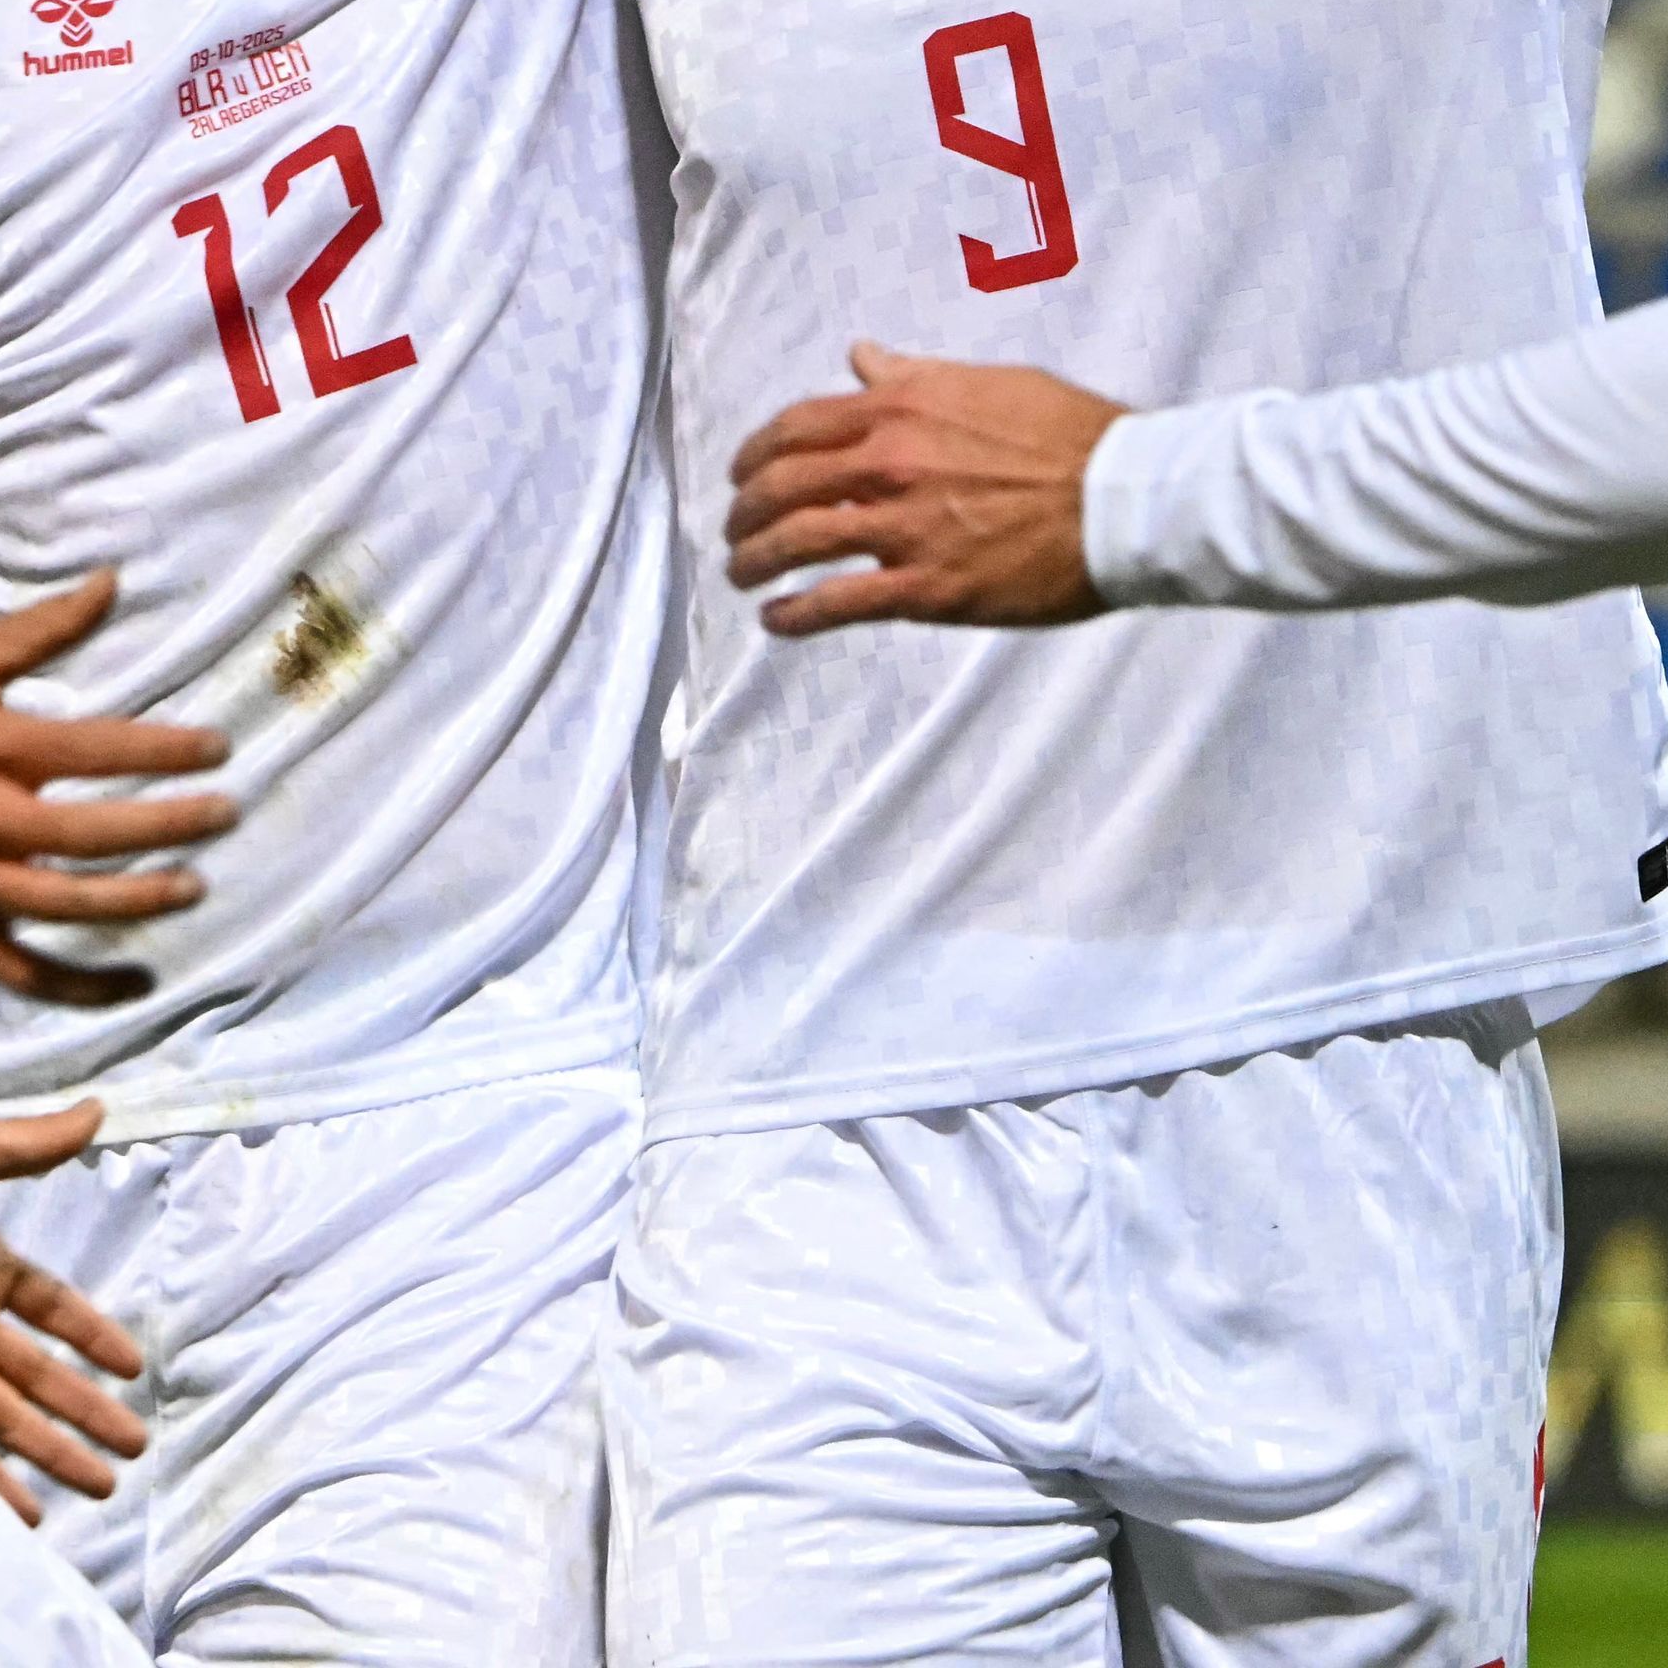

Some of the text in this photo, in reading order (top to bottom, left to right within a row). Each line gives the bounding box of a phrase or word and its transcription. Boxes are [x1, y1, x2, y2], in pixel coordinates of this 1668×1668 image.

[23, 40, 134, 77] hummel
[178, 68, 229, 117] BLR
[249, 40, 312, 91] DEN
[189, 24, 287, 72] 09-10-2025
[188, 78, 312, 138] ZALAEGERSZEG
[922, 11, 1079, 293] 9
[171, 124, 418, 424] 12
